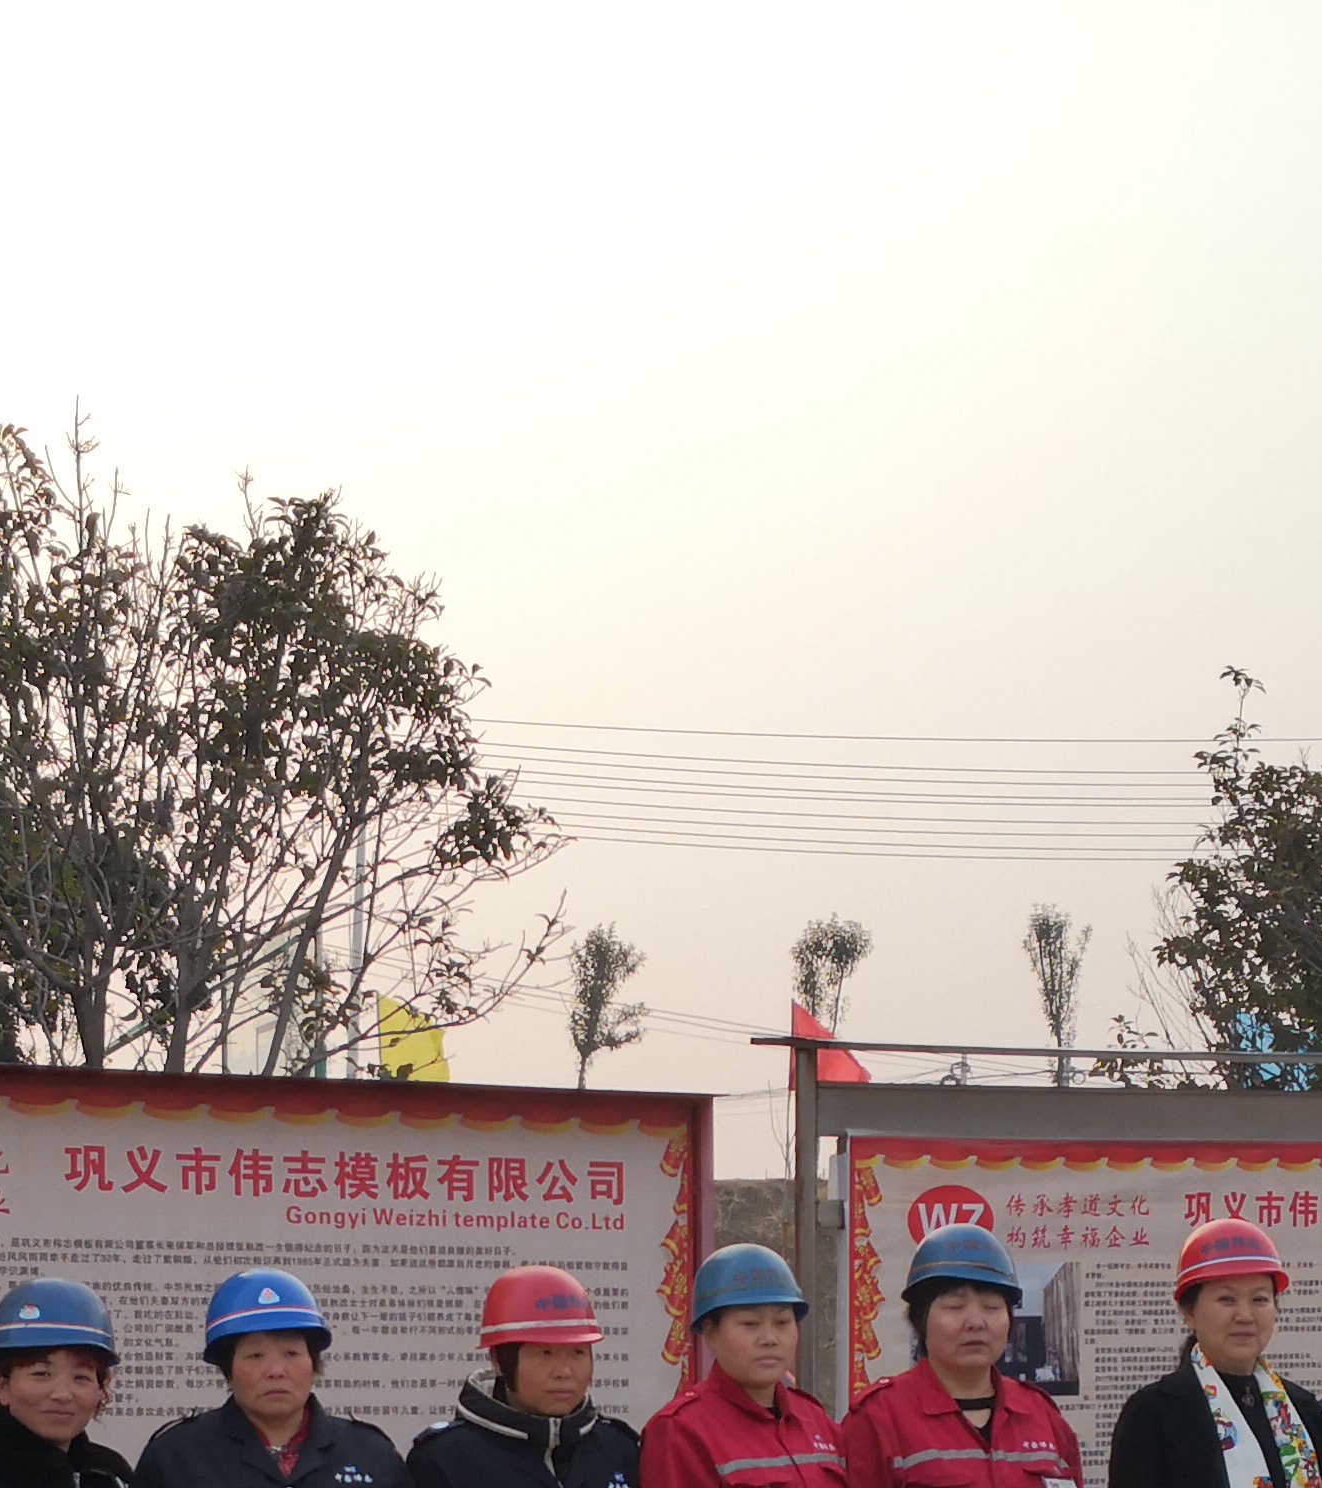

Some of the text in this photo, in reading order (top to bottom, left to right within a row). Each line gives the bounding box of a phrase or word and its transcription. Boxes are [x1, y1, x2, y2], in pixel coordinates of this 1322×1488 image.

[63, 1144, 626, 1207] 巩义市伟志模板有限公司
[285, 1205, 367, 1229] Gongyi
[373, 1208, 448, 1228] Weizhi
[454, 1211, 551, 1233] template
[1006, 1194, 1151, 1219] 传承孝道文化
[1007, 1225, 1151, 1249] 构筑幸福企业
